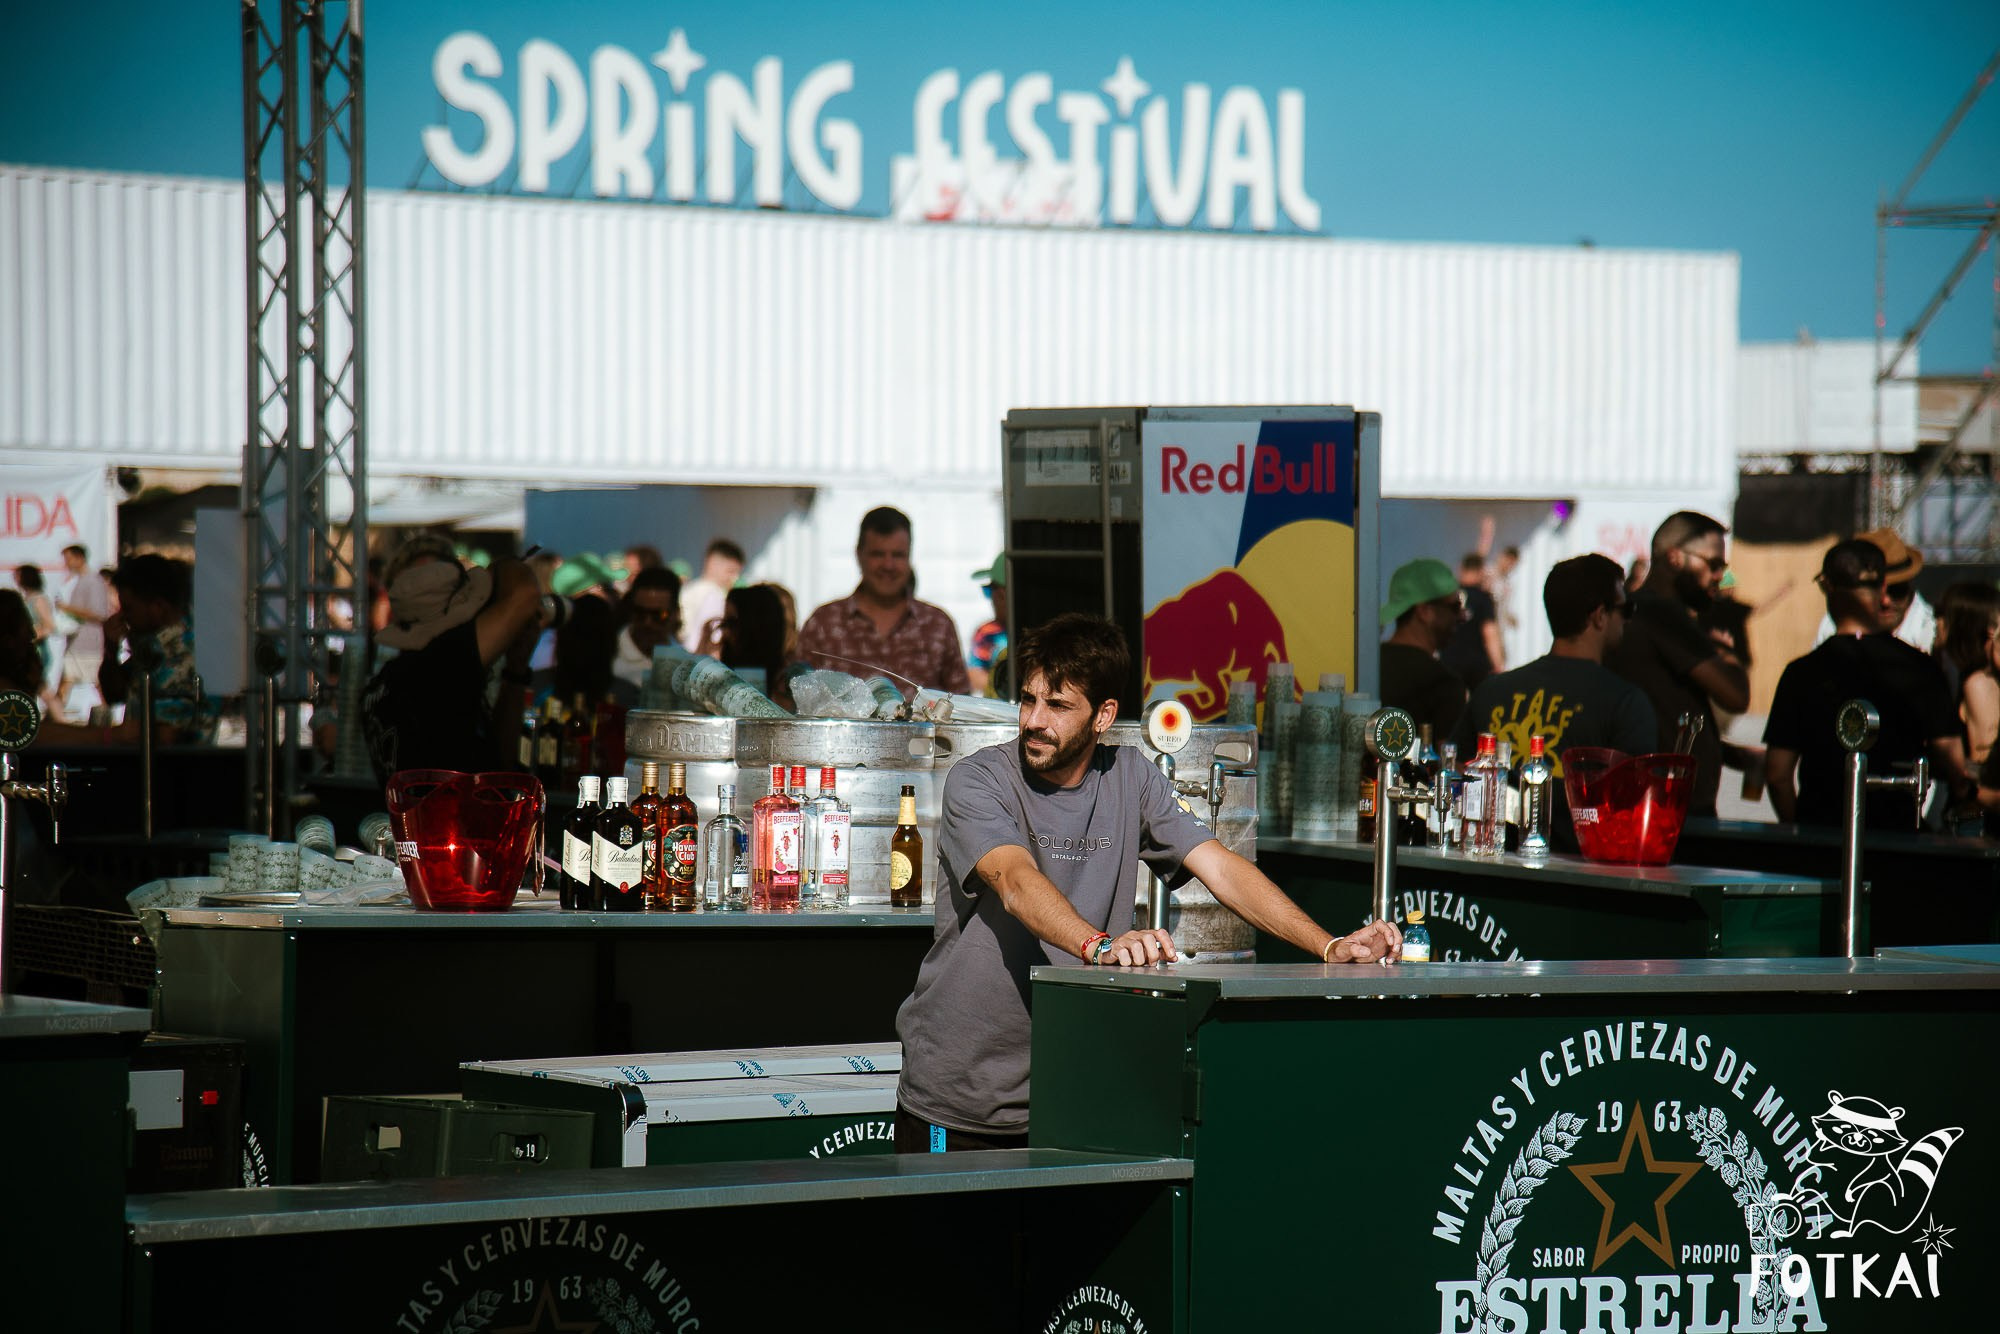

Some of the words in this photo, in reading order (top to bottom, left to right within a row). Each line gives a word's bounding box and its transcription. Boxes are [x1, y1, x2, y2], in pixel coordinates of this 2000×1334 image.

[1161, 444, 1246, 494] Red
[1253, 443, 1336, 495] Bull
[0, 494, 78, 539] IDA
[1488, 688, 1574, 737] STAFF
[1376, 712, 1393, 742] ESTRELLA
[1401, 714, 1413, 743] LEVANTE
[1379, 744, 1396, 757] DESDE
[773, 815, 799, 825] BEEFEATER
[824, 814, 849, 824] BEEFEATER
[672, 841, 698, 852] Havana
[1029, 832, 1073, 850] OLO
[679, 851, 695, 861] Club
[1391, 889, 1480, 931] ERVEZAS
[1479, 915, 1508, 956] DE
[797, 1099, 809, 1114] The
[1596, 1101, 1624, 1134] 19
[1653, 1101, 1682, 1132] 63
[1432, 1096, 1518, 1245] MALTAS
[1511, 1068, 1536, 1106] Y
[1538, 1021, 1712, 1088] CERVEZAS
[1713, 1046, 1757, 1100] DE
[1752, 1085, 1834, 1238] MURCIA
[247, 1131, 270, 1188] MURCI
[525, 1143, 536, 1158] 19
[809, 1146, 821, 1159] Y
[439, 1259, 460, 1287] Y
[463, 1217, 608, 1272] CERVEZAS
[609, 1232, 646, 1272] DE
[1532, 1246, 1586, 1268] SABOR
[1681, 1243, 1741, 1265] PROPIO
[511, 1278, 534, 1304] 19
[559, 1275, 583, 1301] 63
[1066, 1285, 1120, 1310] CERVEZAS
[1120, 1300, 1135, 1323] DE
[1435, 1274, 1828, 1334] ESTRELLA
[1084, 1317, 1093, 1331] 19
[1101, 1319, 1111, 1334] 63
